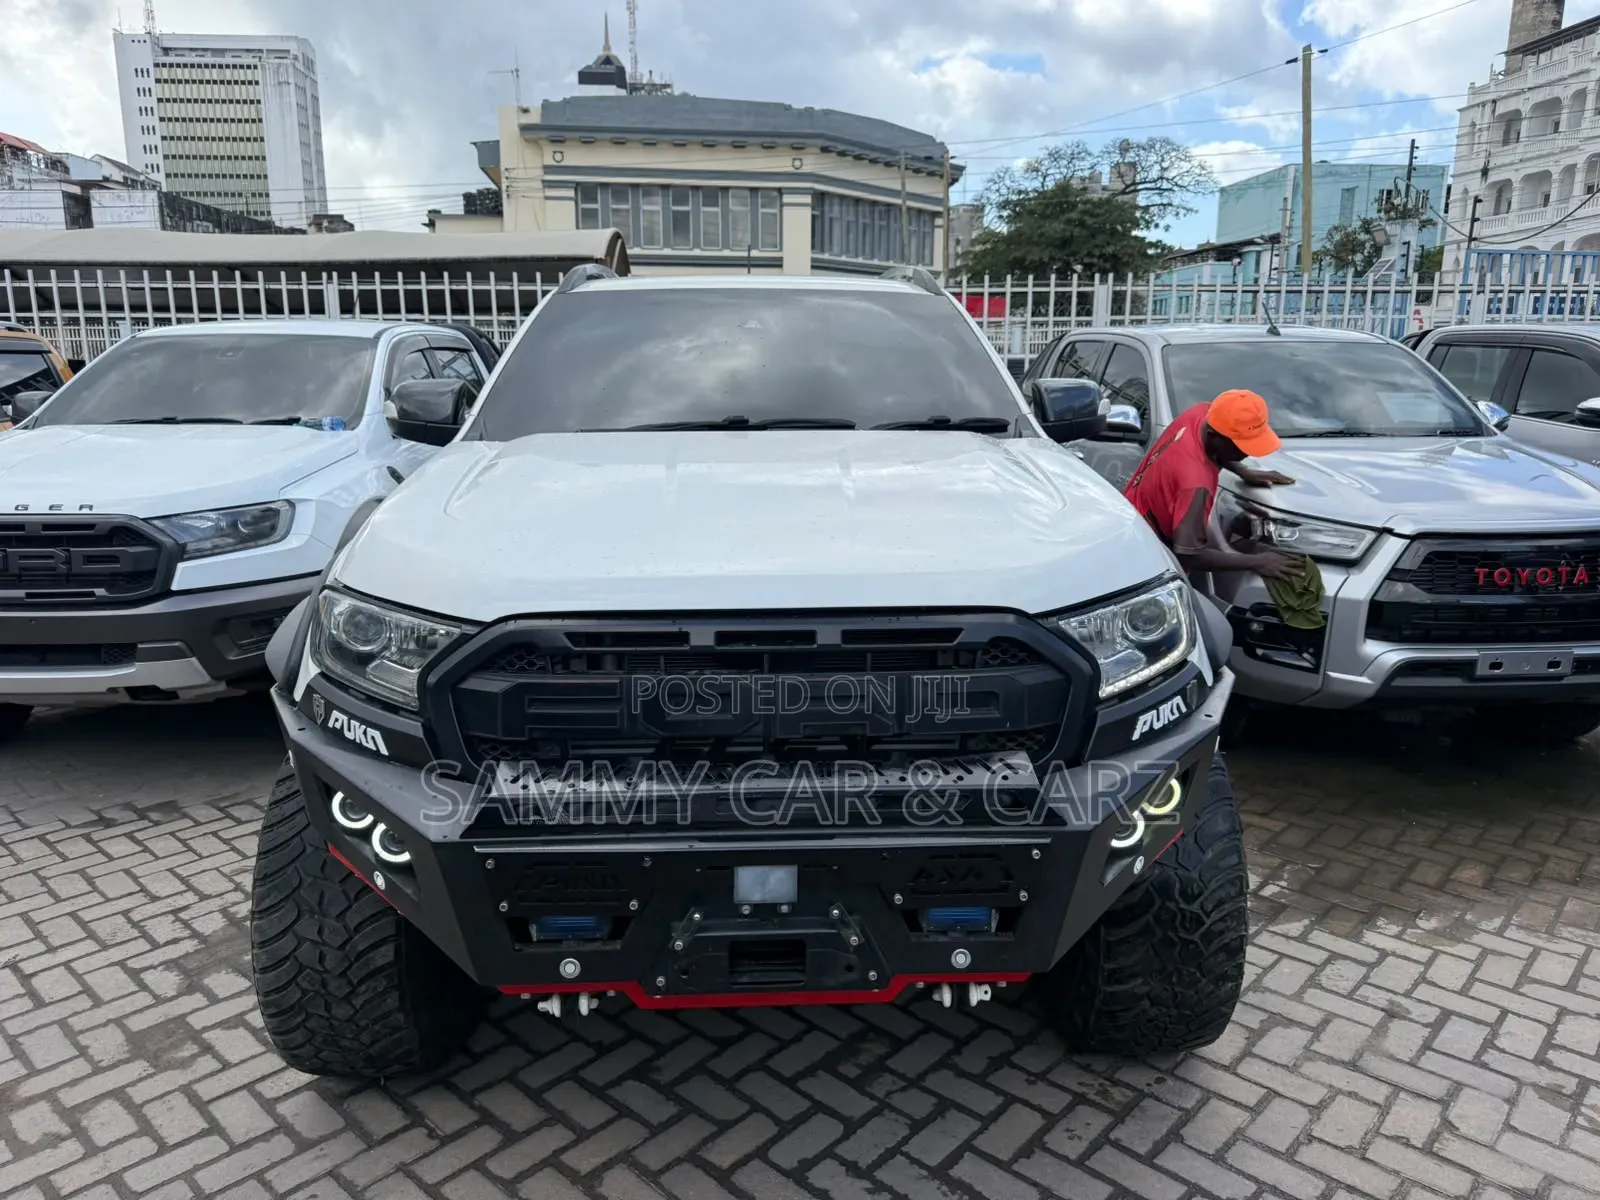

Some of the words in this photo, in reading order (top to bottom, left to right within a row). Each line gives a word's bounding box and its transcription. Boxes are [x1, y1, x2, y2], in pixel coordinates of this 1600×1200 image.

[1474, 567, 1590, 587] TOYOTA
[327, 709, 389, 756] PUKA
[1132, 695, 1188, 741] PUKA
